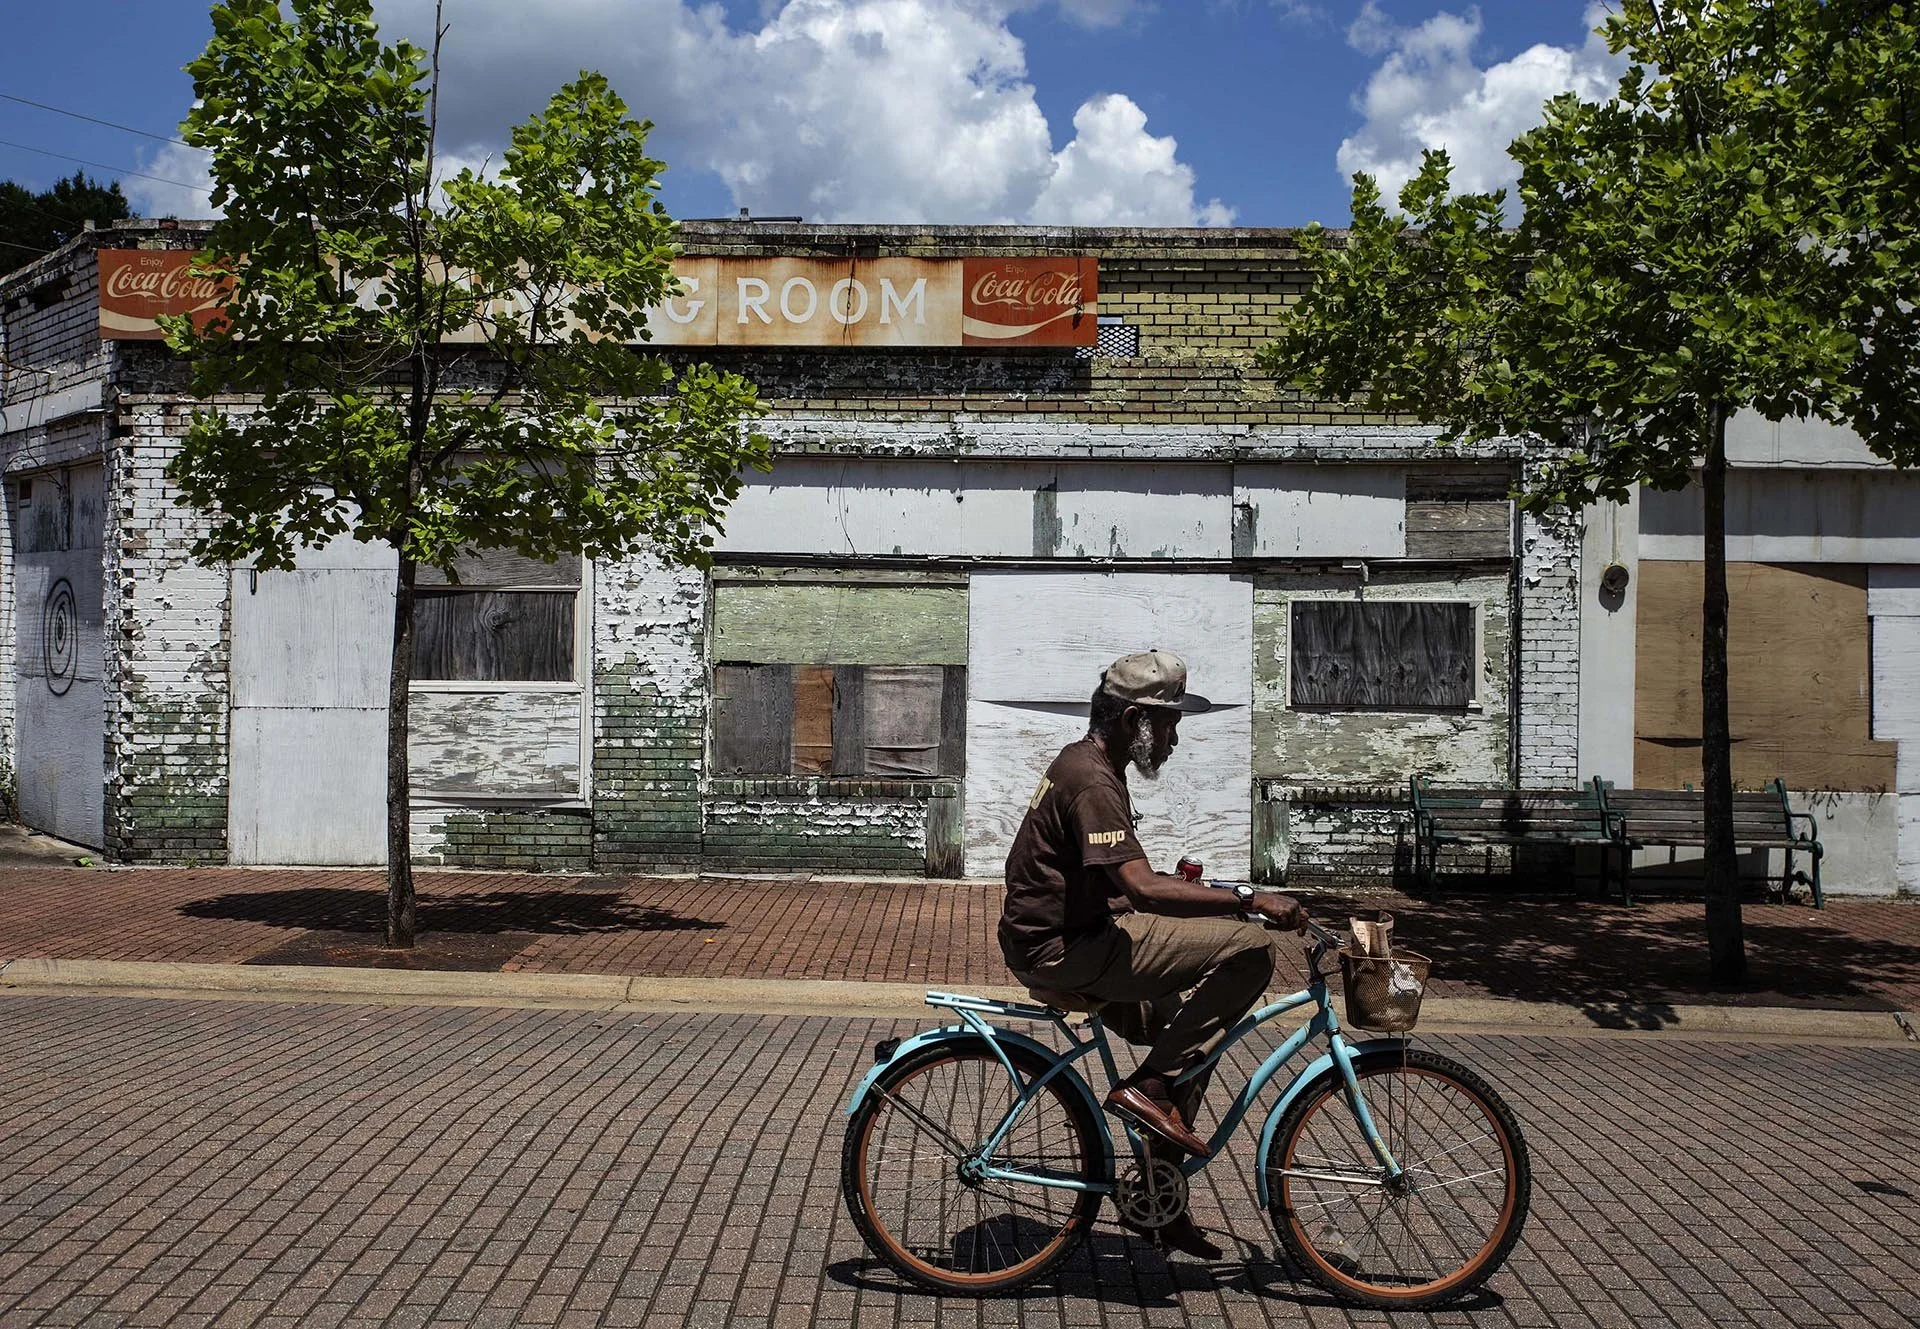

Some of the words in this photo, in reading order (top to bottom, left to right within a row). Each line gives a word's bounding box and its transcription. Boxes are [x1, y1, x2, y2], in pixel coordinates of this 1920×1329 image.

[140, 256, 164, 267] Enjoy
[1005, 264, 1027, 275] Enjo
[107, 264, 217, 298] Coca-Cola
[971, 271, 1088, 305] Coca-Cola
[737, 276, 927, 324] ROOM
[1088, 830, 1126, 848] mojo
